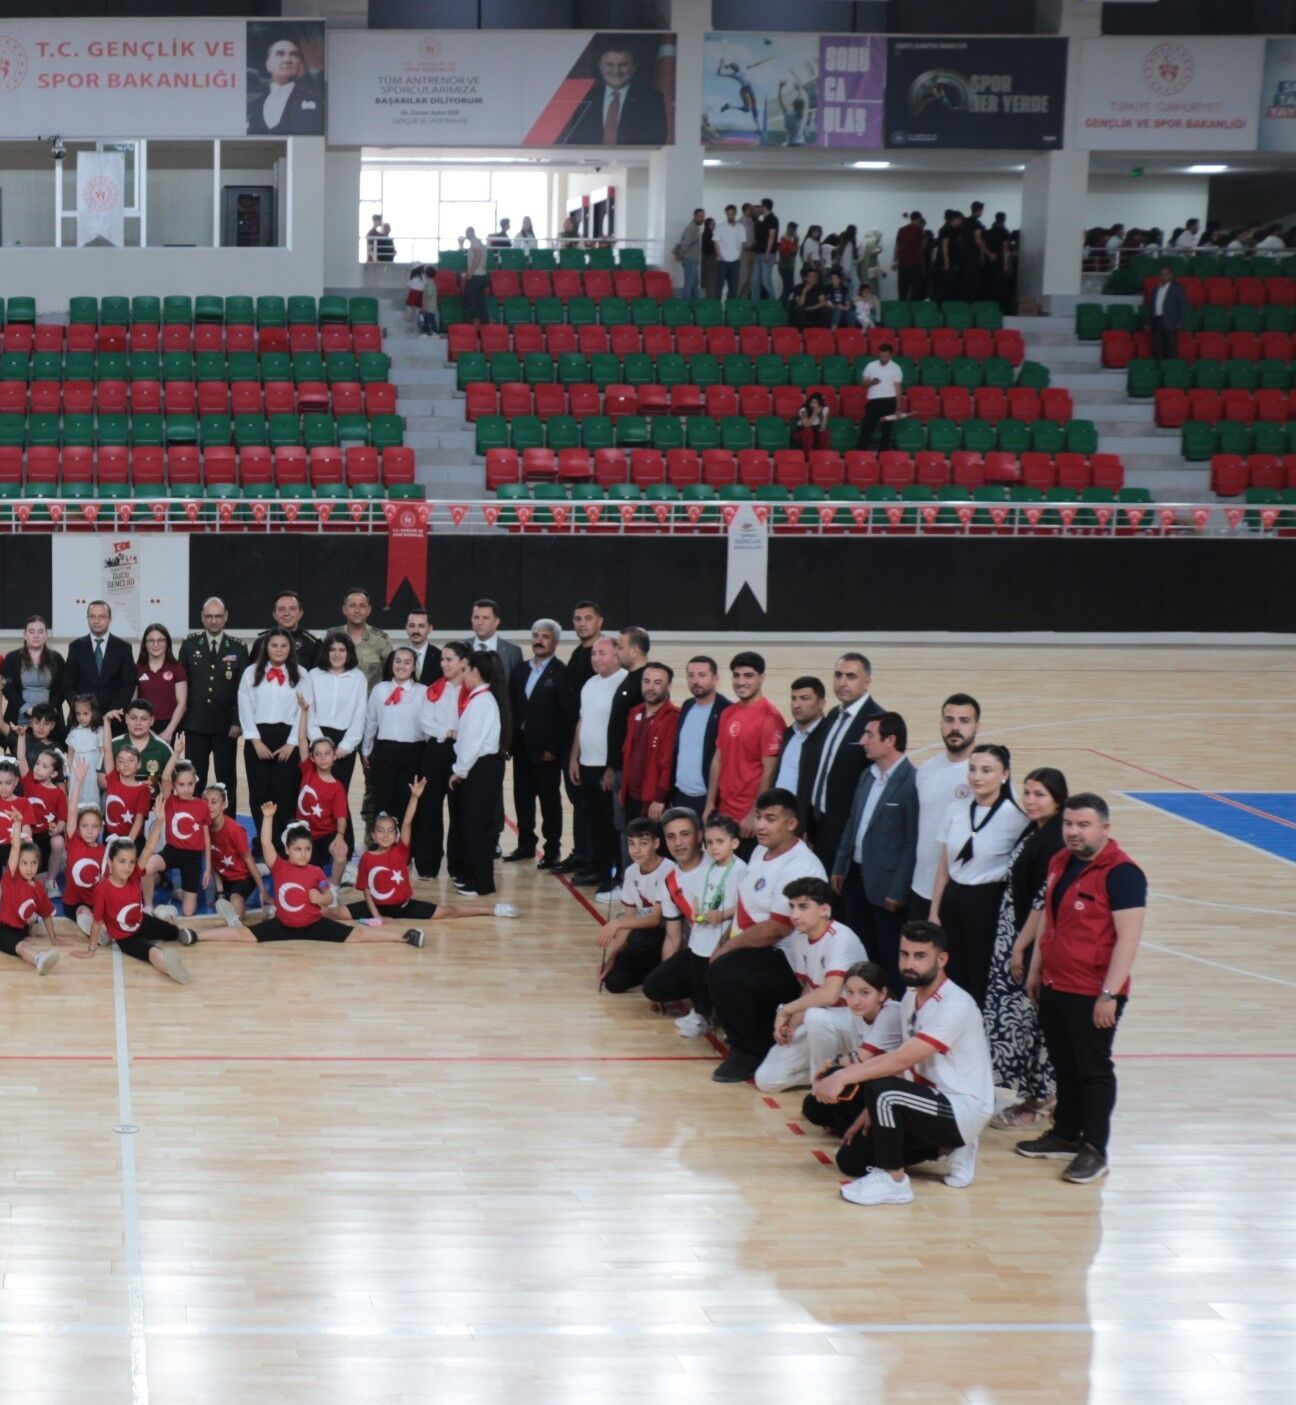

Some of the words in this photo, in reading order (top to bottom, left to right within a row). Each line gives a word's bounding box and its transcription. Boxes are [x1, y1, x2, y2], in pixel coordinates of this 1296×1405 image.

[36, 41, 79, 58] T.C.
[87, 37, 195, 61] GENÇLİK
[205, 41, 235, 57] VE
[38, 72, 100, 89] SPOR
[108, 69, 237, 89] BAKANLIĞI
[1137, 118, 1150, 128] VE
[1154, 118, 1183, 128] SPOR
